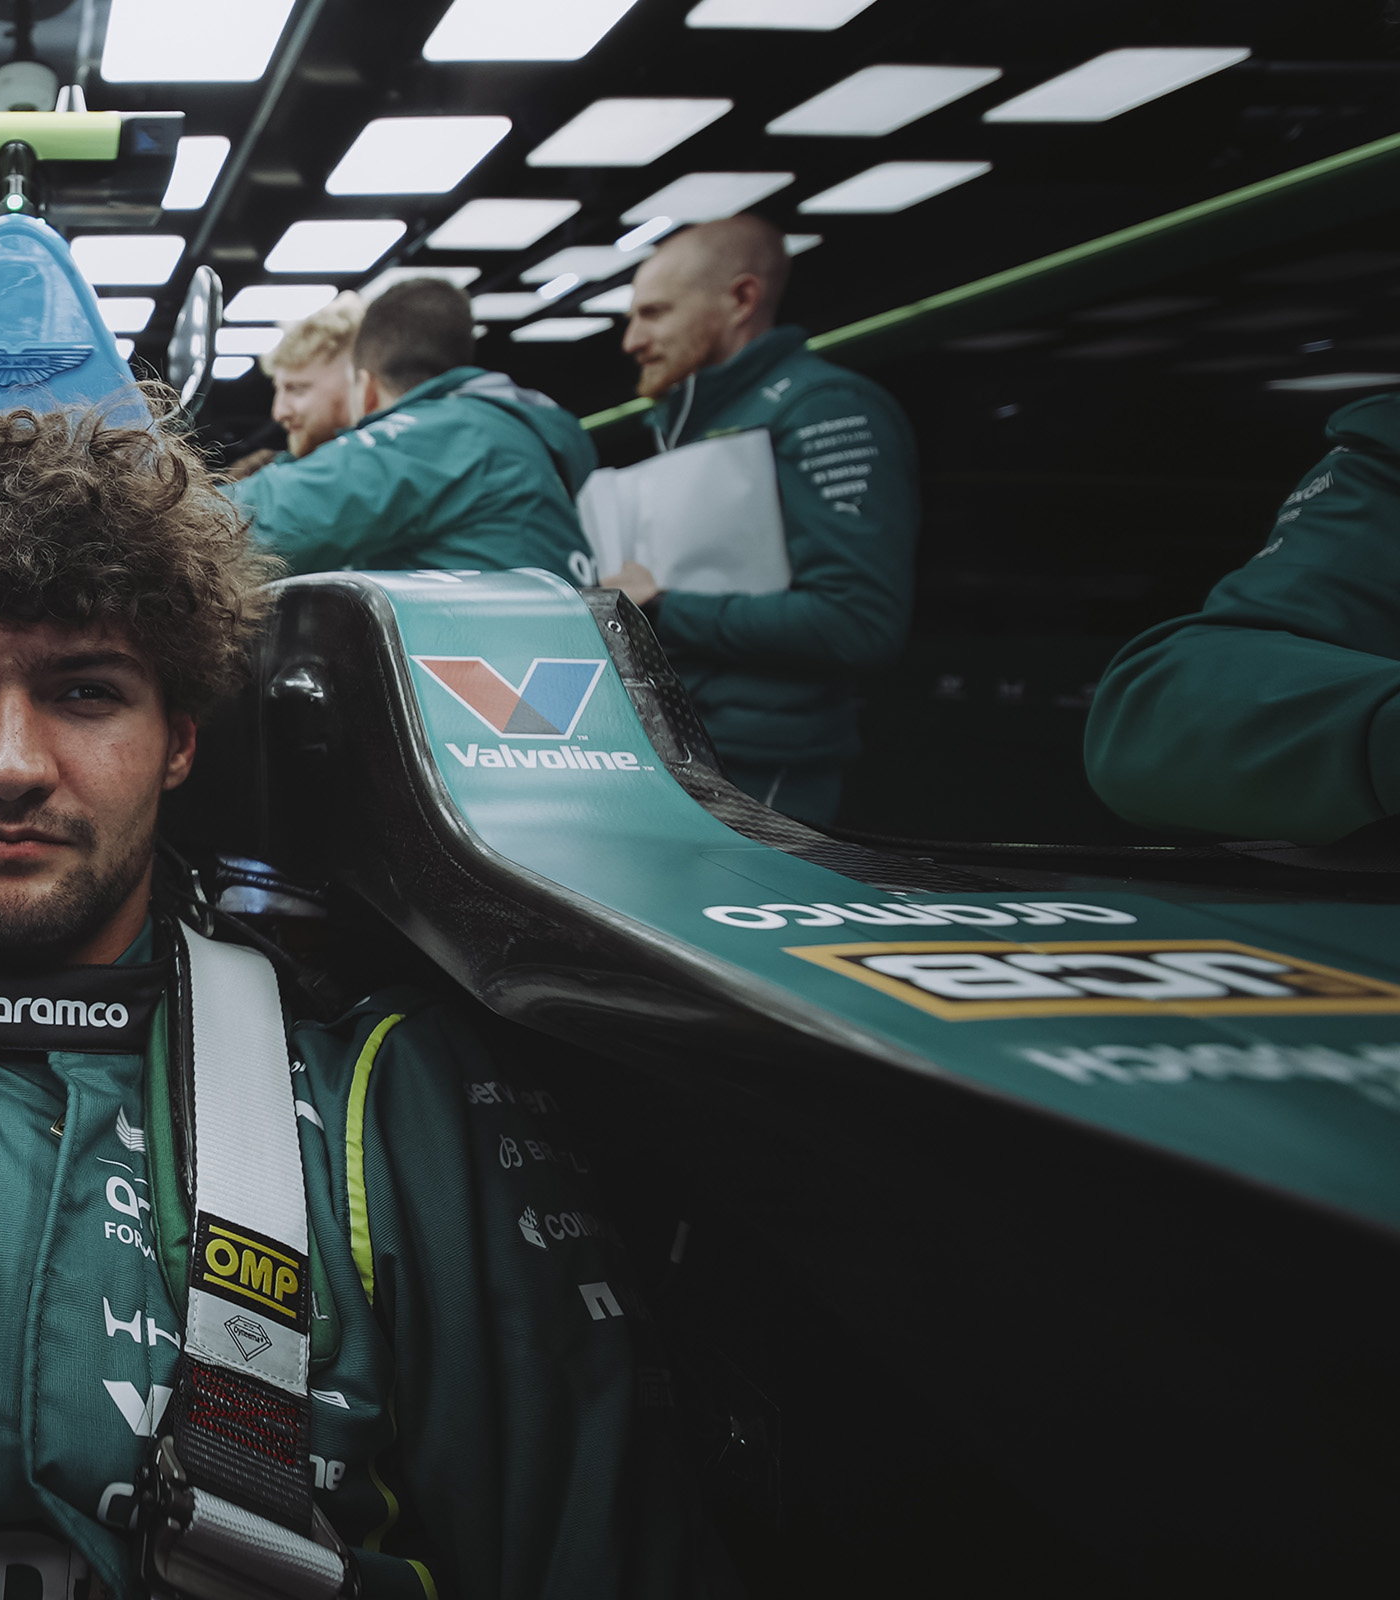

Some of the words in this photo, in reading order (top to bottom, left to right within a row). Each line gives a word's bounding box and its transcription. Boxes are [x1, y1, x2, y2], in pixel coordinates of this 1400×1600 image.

[702, 902, 1137, 930] aramco
[860, 953, 1294, 999] JCB
[205, 1238, 298, 1302] OMP
